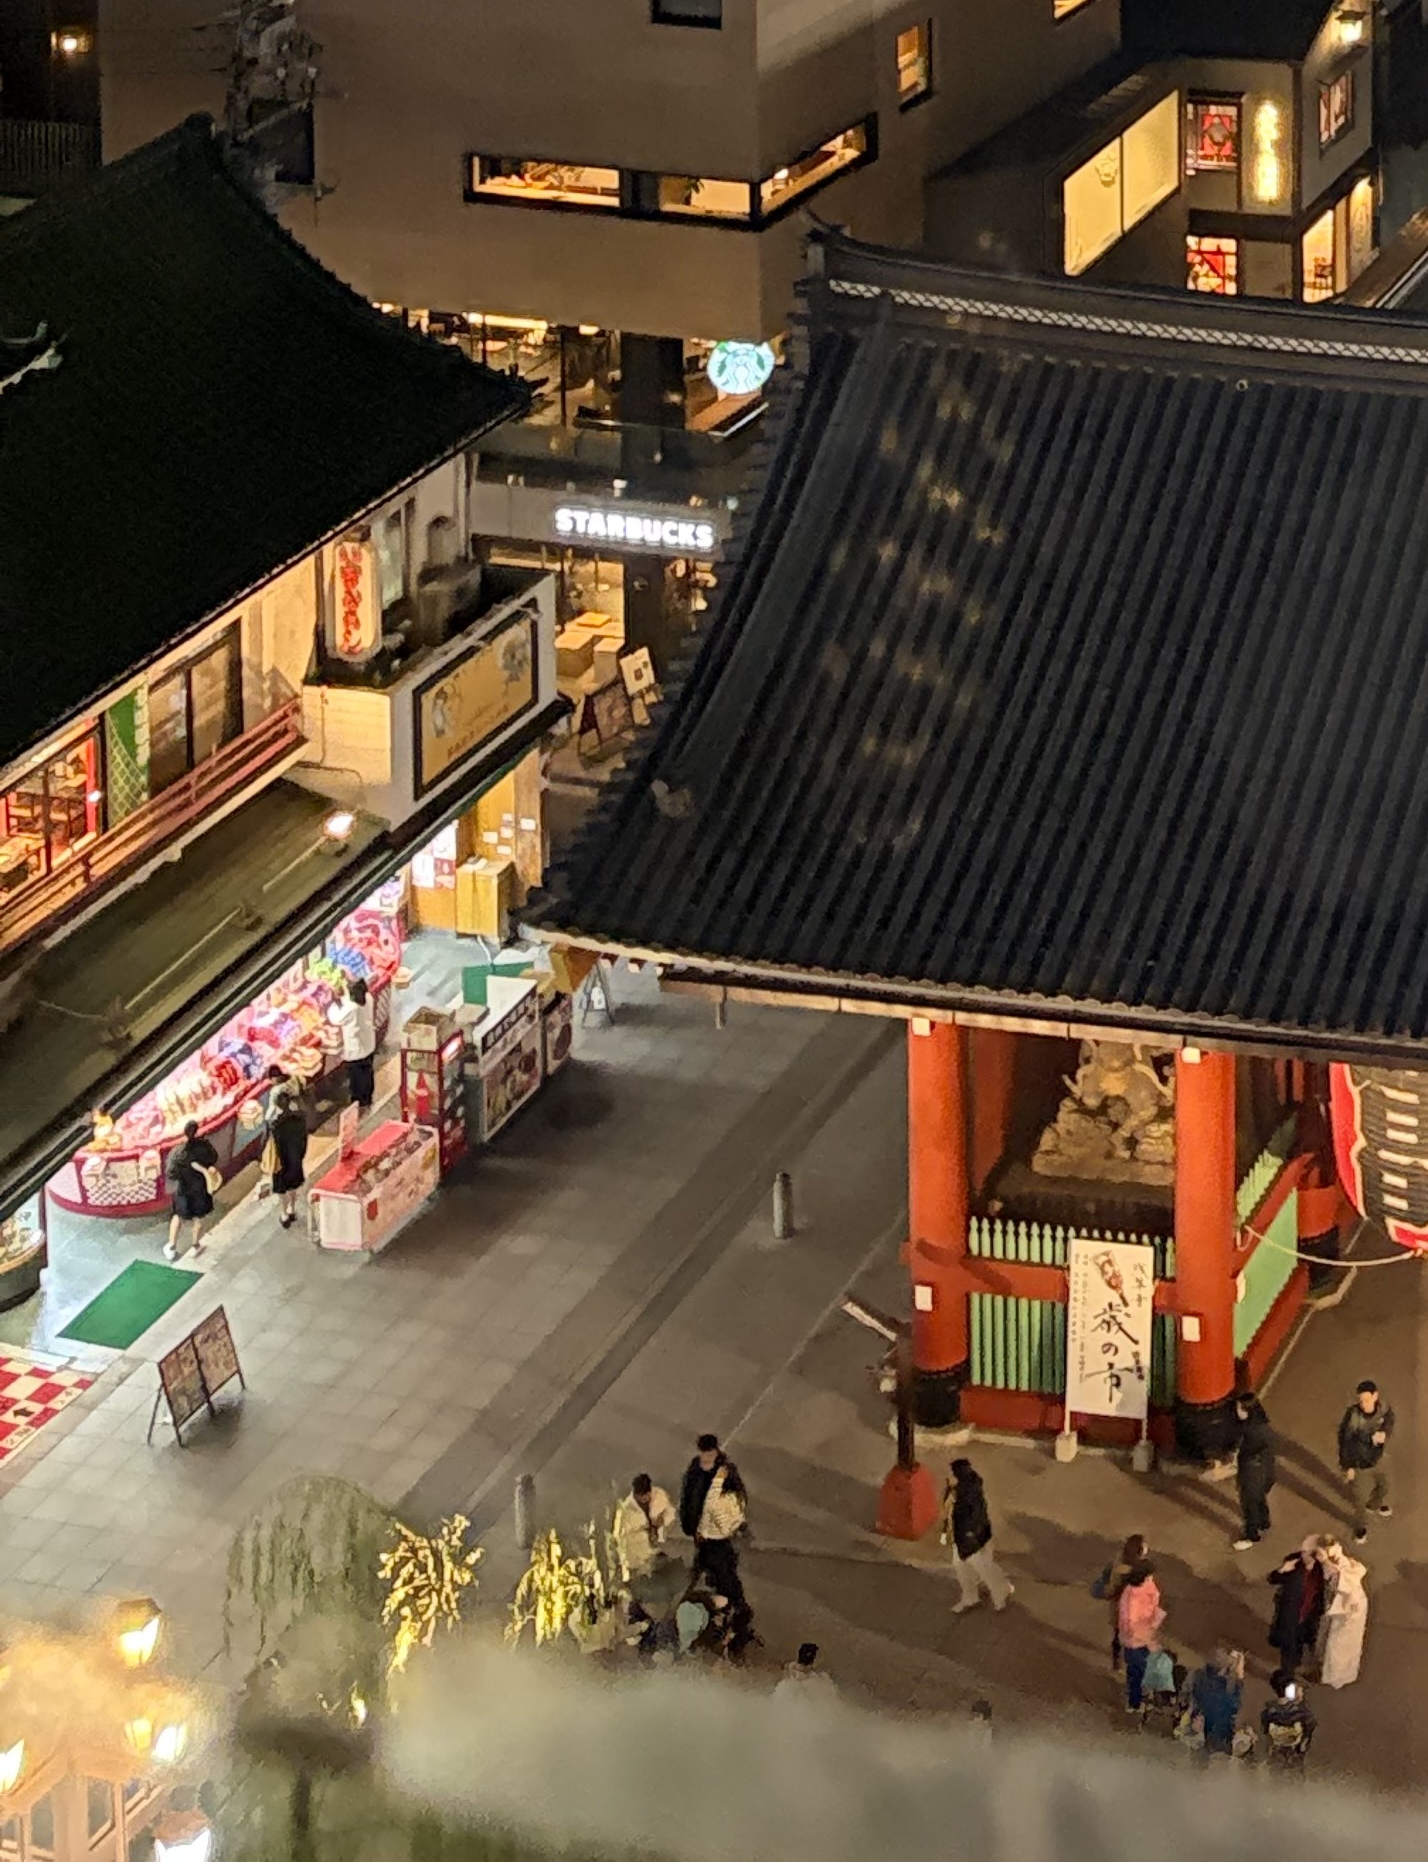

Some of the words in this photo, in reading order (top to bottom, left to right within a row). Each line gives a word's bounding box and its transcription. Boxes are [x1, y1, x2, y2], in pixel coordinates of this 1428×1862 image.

[555, 507, 714, 549] STARBUCKS
[1084, 1301, 1140, 1404] 歳の市
